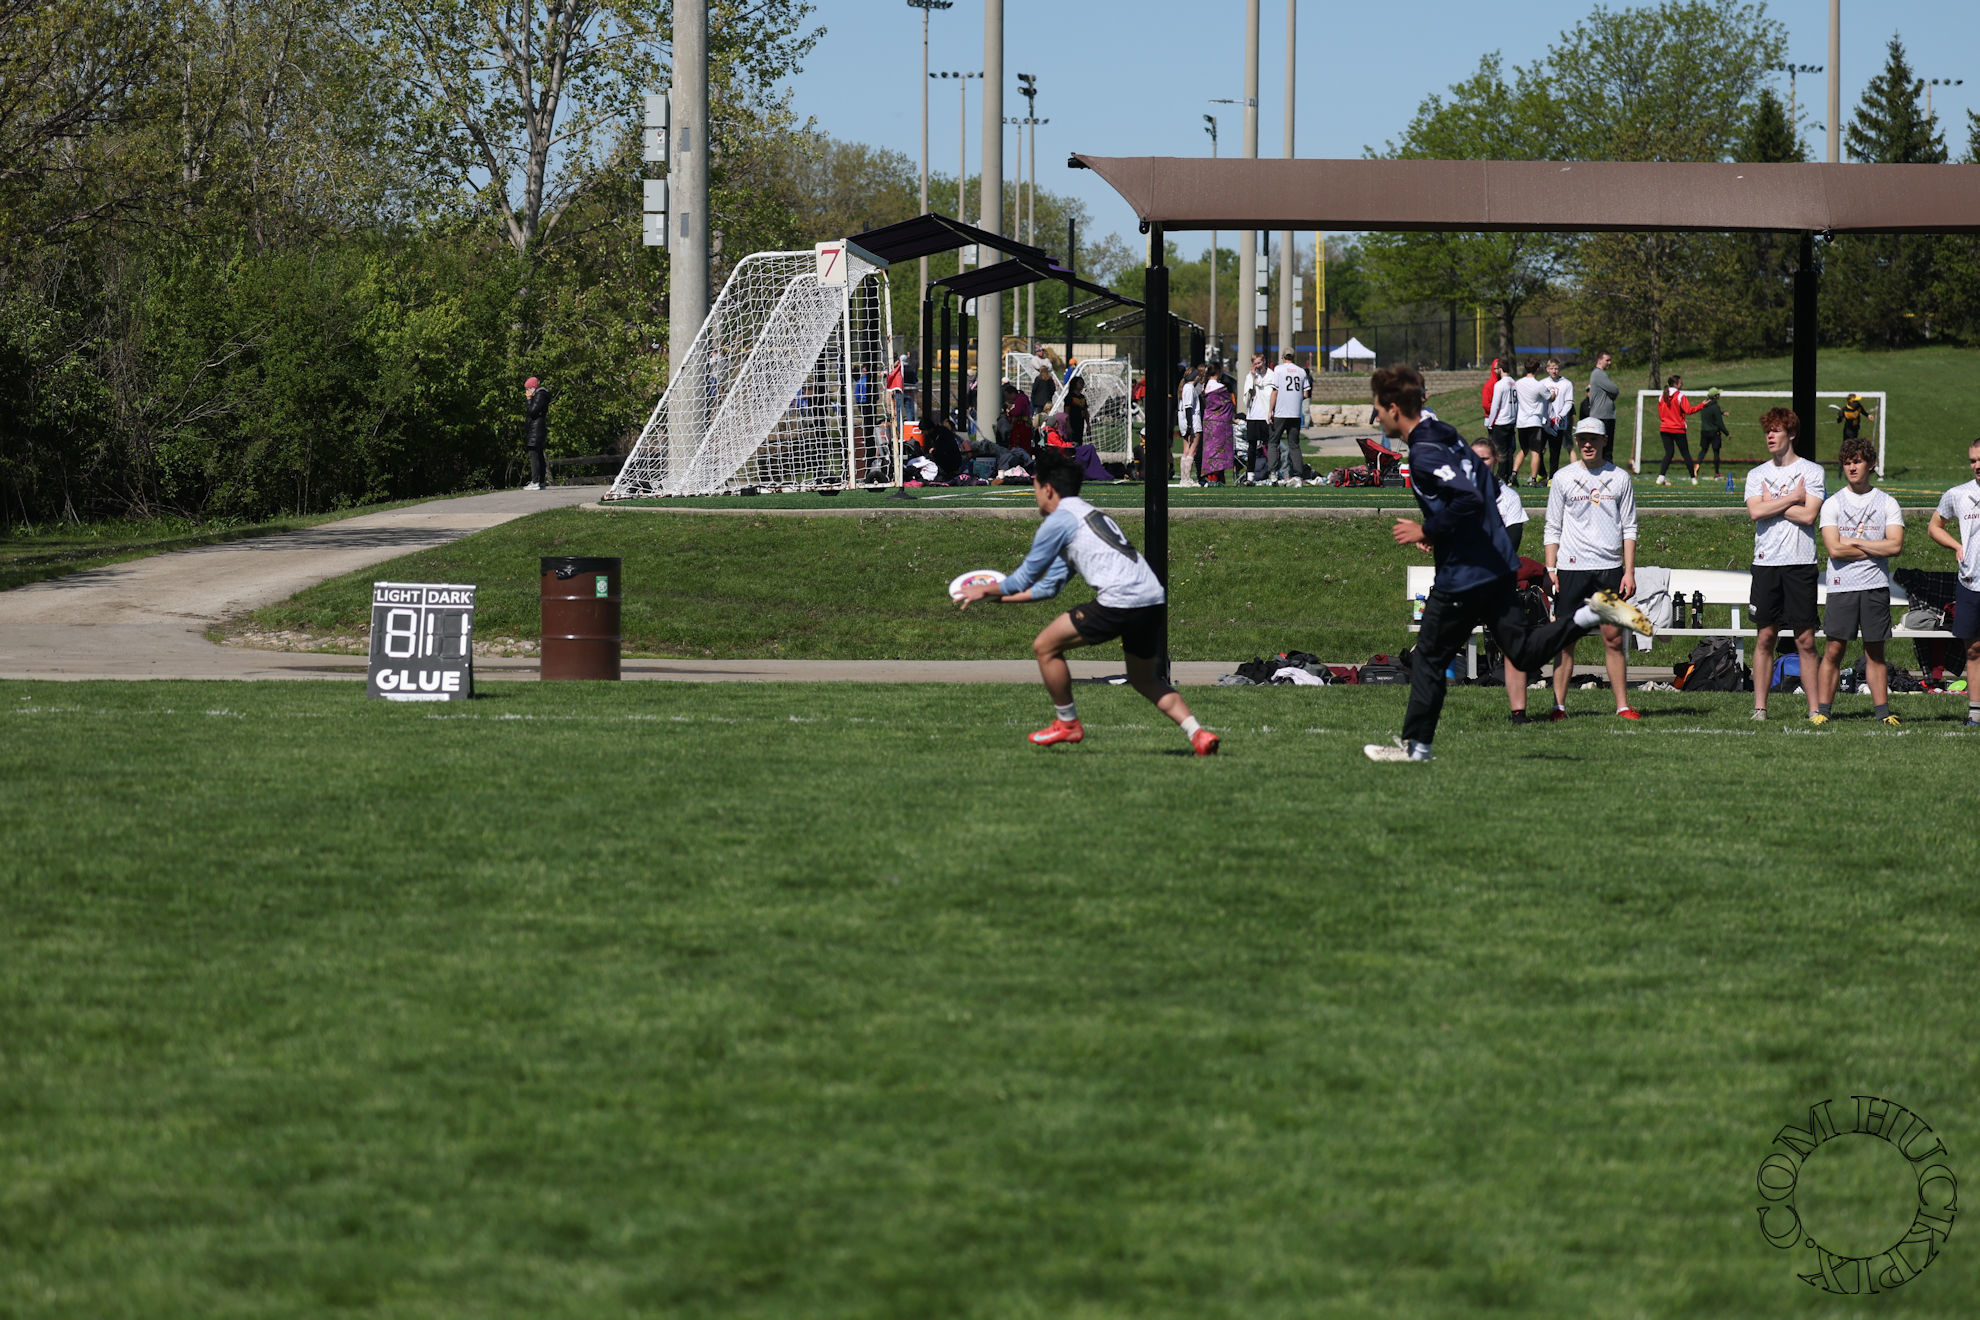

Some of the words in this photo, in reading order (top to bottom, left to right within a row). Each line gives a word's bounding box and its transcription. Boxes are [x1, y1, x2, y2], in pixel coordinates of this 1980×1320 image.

[821, 249, 841, 277] 7
[1285, 375, 1300, 392] 26
[1570, 495, 1590, 503] CALVIN
[1102, 515, 1128, 546] 9
[376, 589, 421, 603] LIGHT
[428, 591, 471, 604] DARK
[384, 608, 418, 658] 8
[375, 669, 460, 692] GLUE
